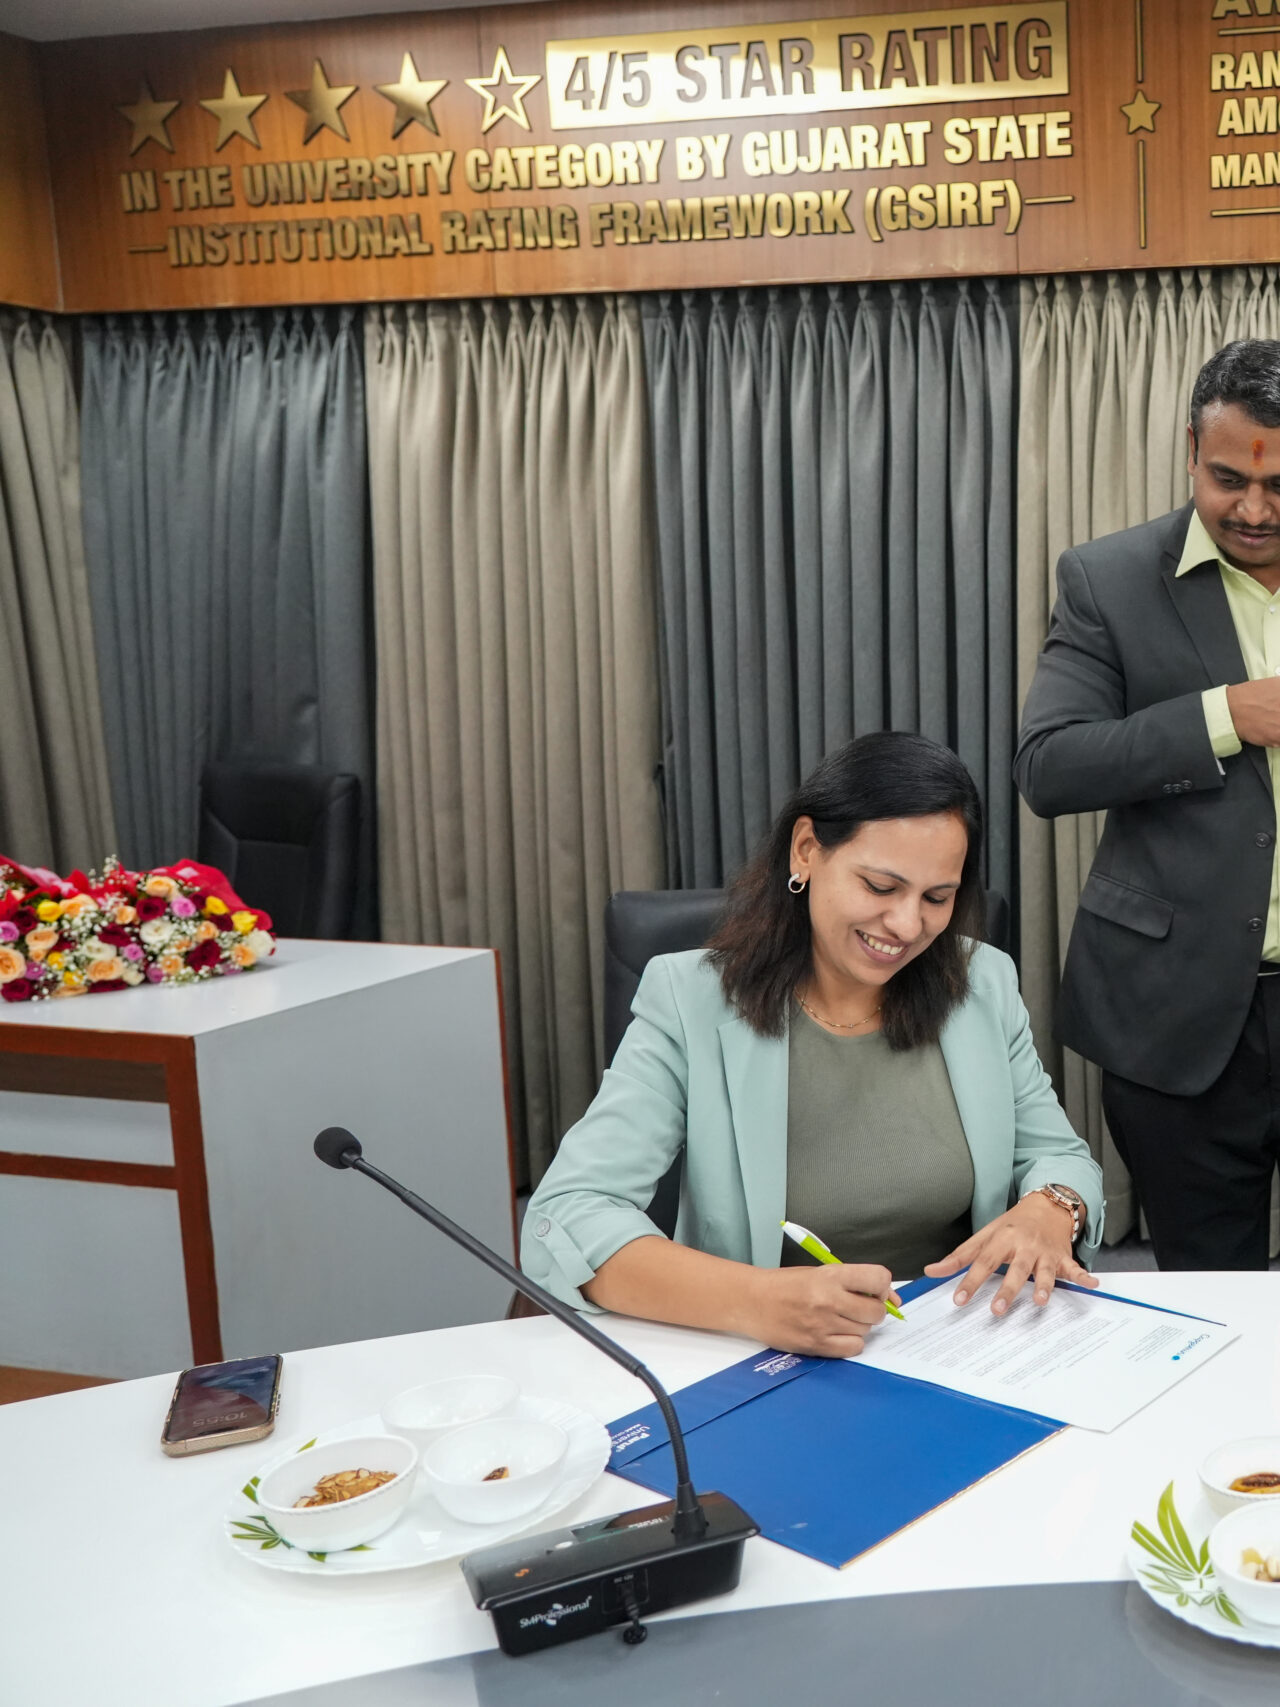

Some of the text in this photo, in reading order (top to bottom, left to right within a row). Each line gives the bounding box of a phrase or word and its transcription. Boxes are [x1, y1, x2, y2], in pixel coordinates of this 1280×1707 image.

[565, 18, 1053, 111] 4/5 STAR RATING
[119, 111, 1073, 213] IN THE UNIVERSITY CATEGORY BY GUJARAT STATE
[168, 178, 1022, 268] INSTITUTIONAL RATING FRAMEWORK (GSIRF)
